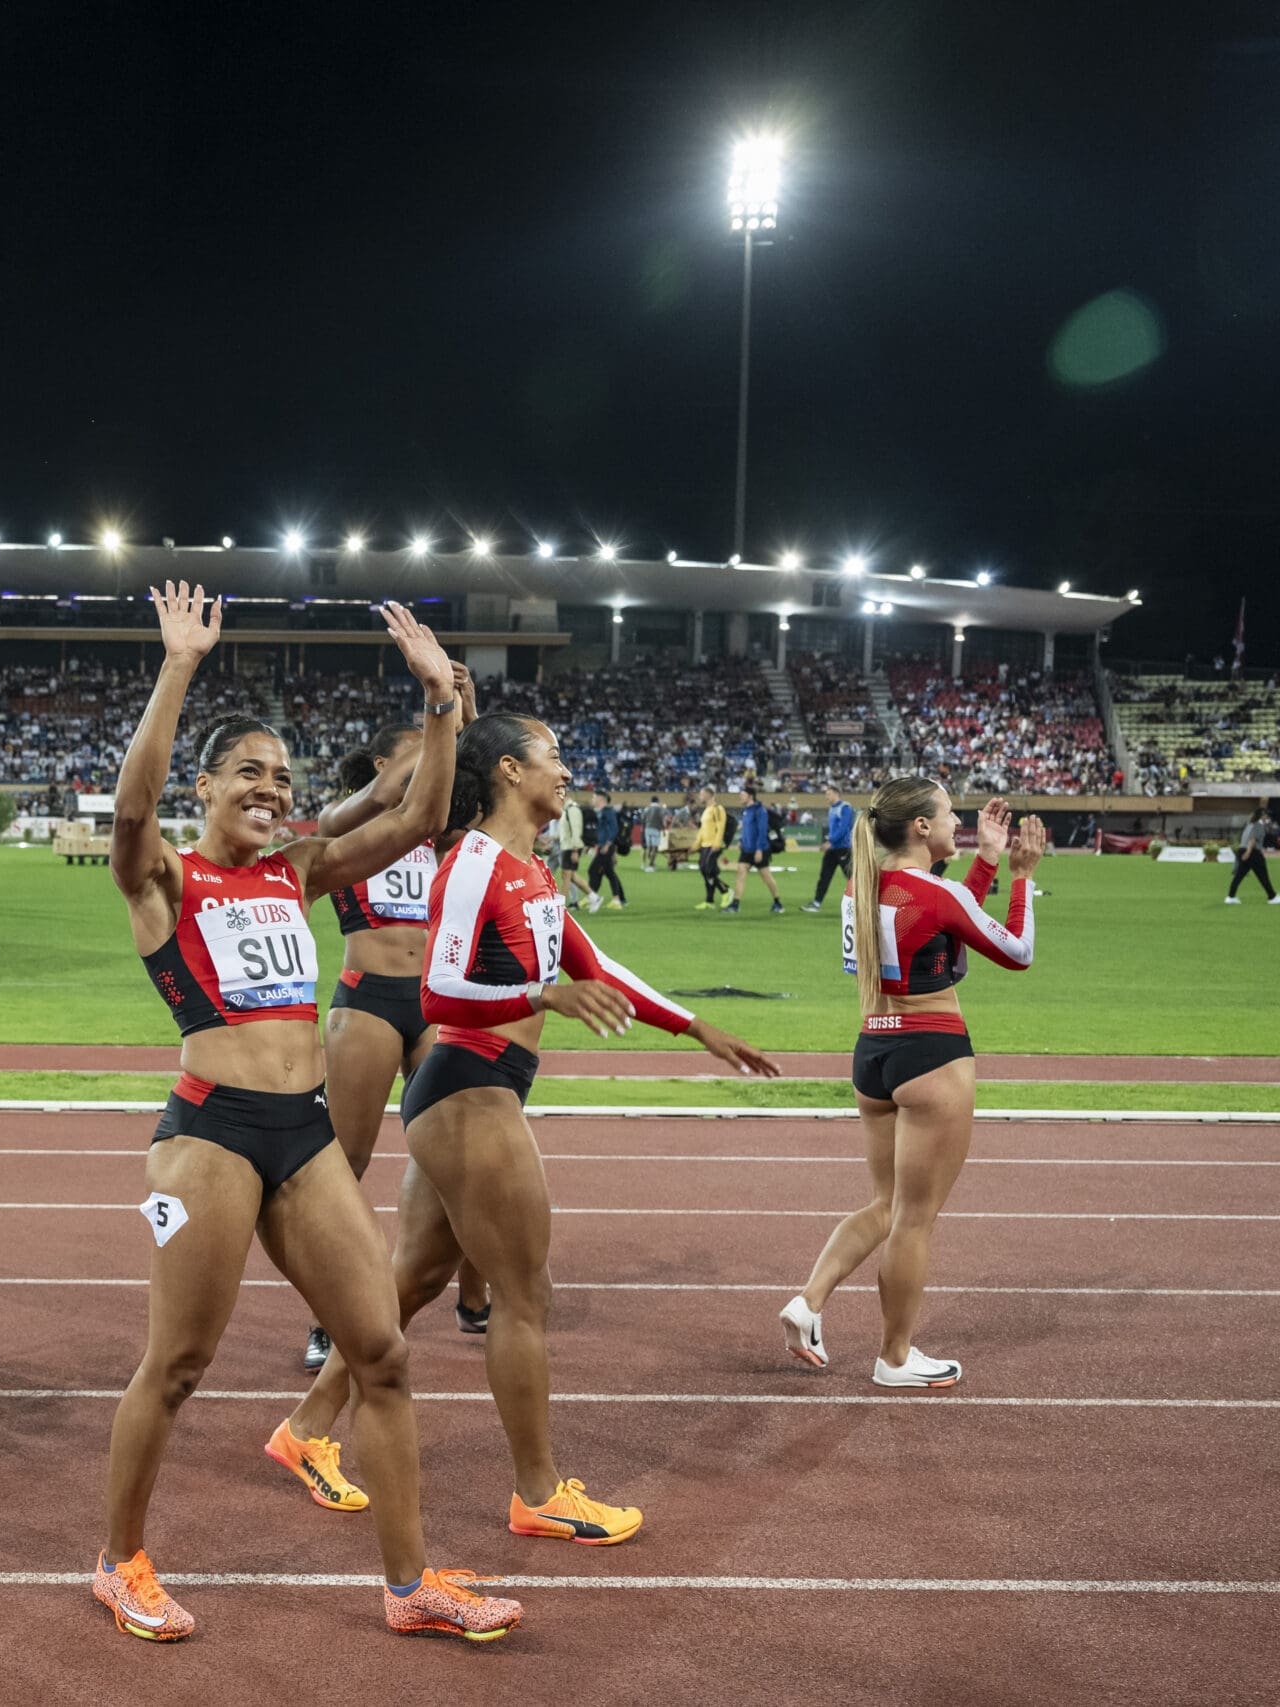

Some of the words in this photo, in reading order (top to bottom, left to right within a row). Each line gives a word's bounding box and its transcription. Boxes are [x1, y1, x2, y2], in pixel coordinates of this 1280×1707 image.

[203, 873, 222, 884] UBS
[251, 903, 291, 924] UBS
[237, 933, 305, 981] SUI
[868, 1016, 902, 1030] SUISSE
[157, 1200, 169, 1227] 5
